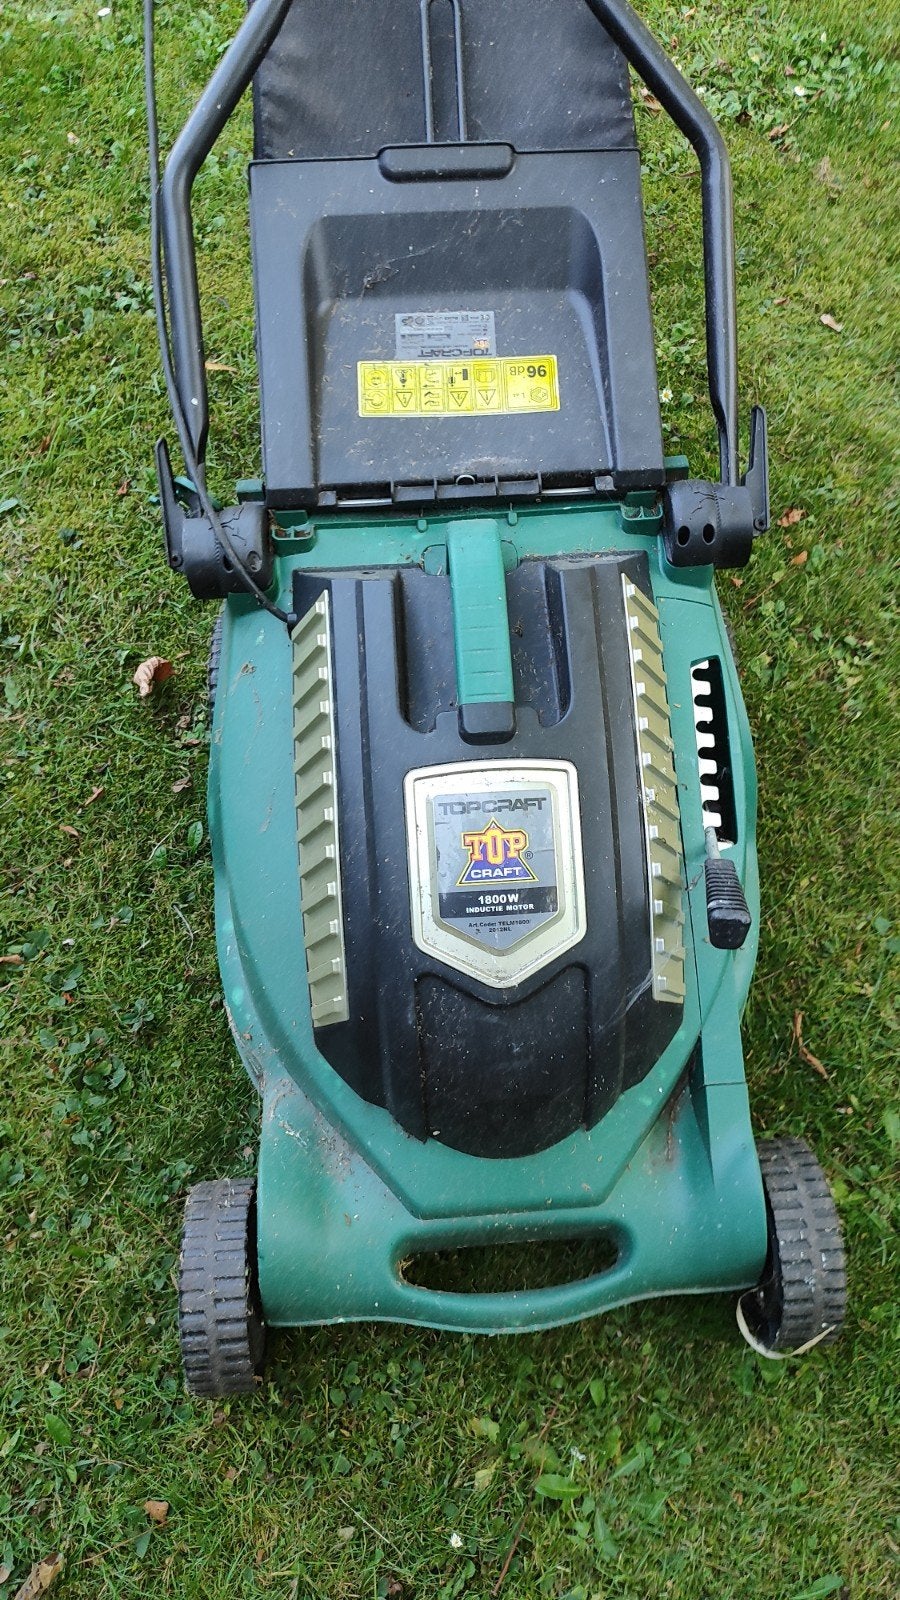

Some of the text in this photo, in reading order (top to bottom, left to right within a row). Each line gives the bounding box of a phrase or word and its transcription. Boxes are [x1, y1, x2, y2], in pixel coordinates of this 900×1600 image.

[509, 364, 547, 379] 96 dB
[439, 798, 546, 816] TOPCRAFT
[465, 828, 527, 865] TOP
[471, 867, 522, 879] CRAFT
[478, 893, 519, 905] 1800W
[466, 903, 535, 914] INDUCTIE MOTOR
